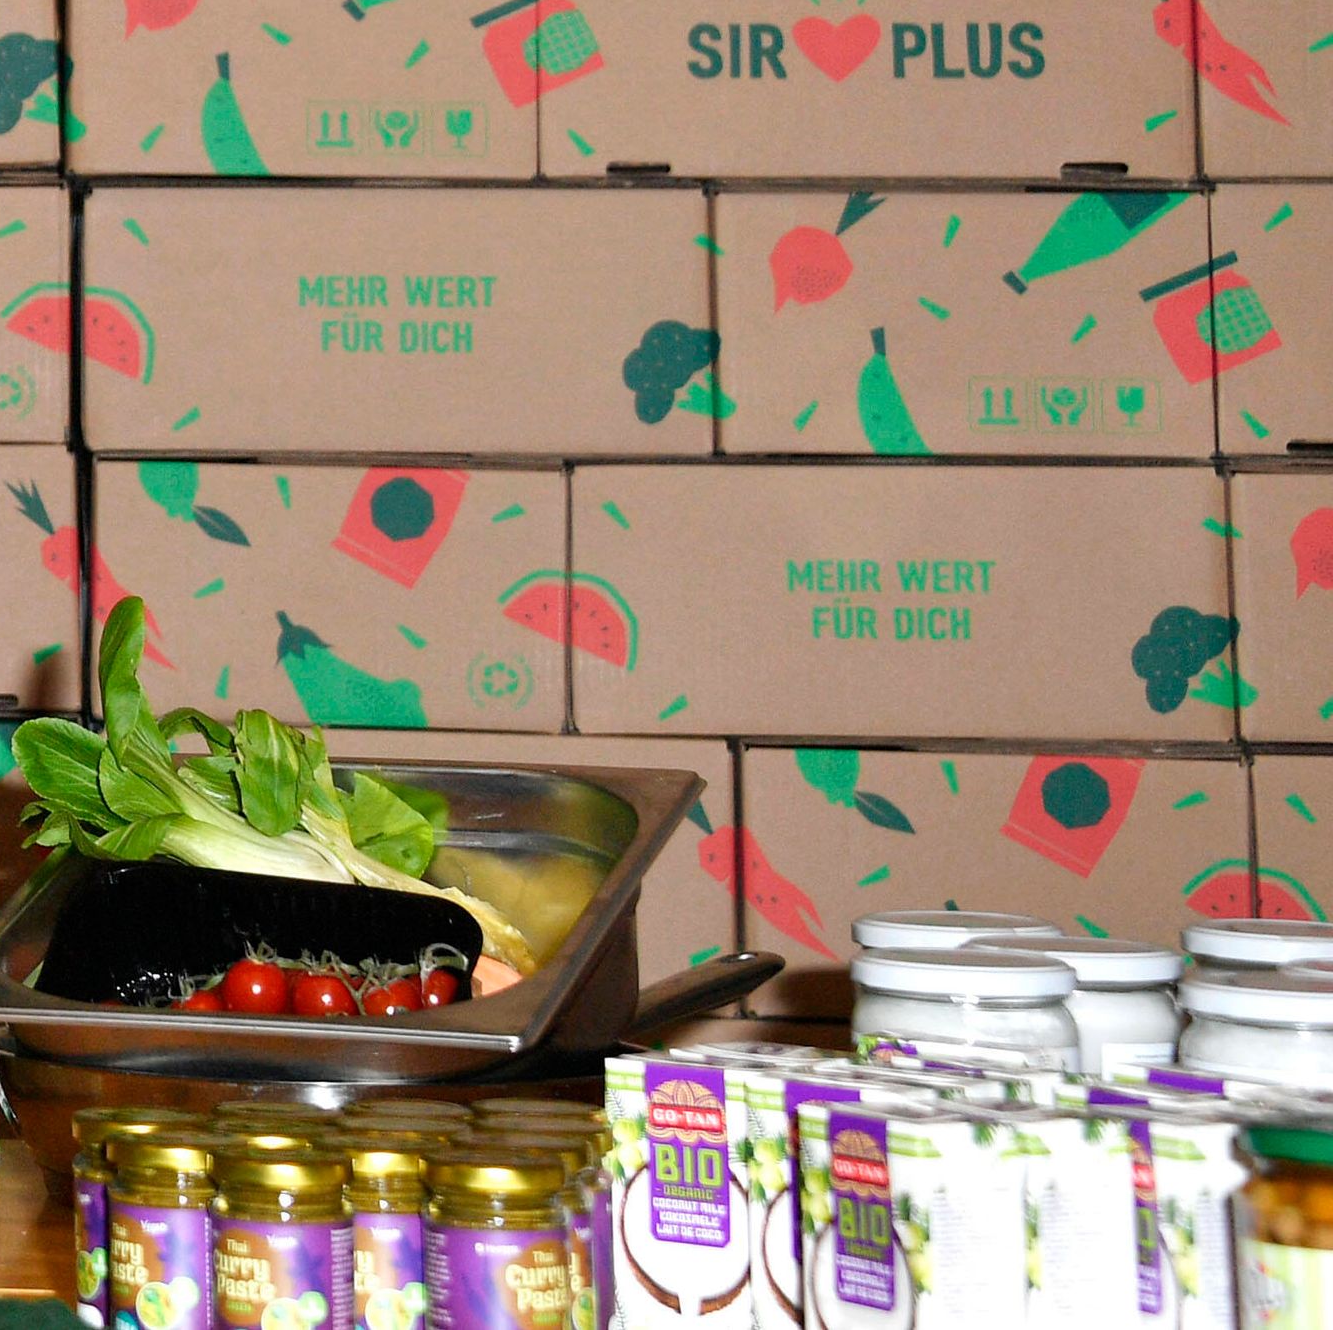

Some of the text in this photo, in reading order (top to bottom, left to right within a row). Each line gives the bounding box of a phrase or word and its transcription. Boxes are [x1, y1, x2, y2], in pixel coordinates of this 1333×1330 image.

[688, 21, 1047, 80] SIR PLUS
[298, 274, 496, 309] MEHR WERT
[321, 312, 474, 355] FÜR DICH
[785, 559, 995, 595] MEHR WERT
[811, 598, 972, 642] FÜR DICH
[652, 1107, 719, 1128] GO-TAN
[654, 1143, 723, 1188] BIO
[838, 1197, 890, 1247] BIO
[111, 1238, 143, 1266] rry
[111, 1261, 149, 1286] aste
